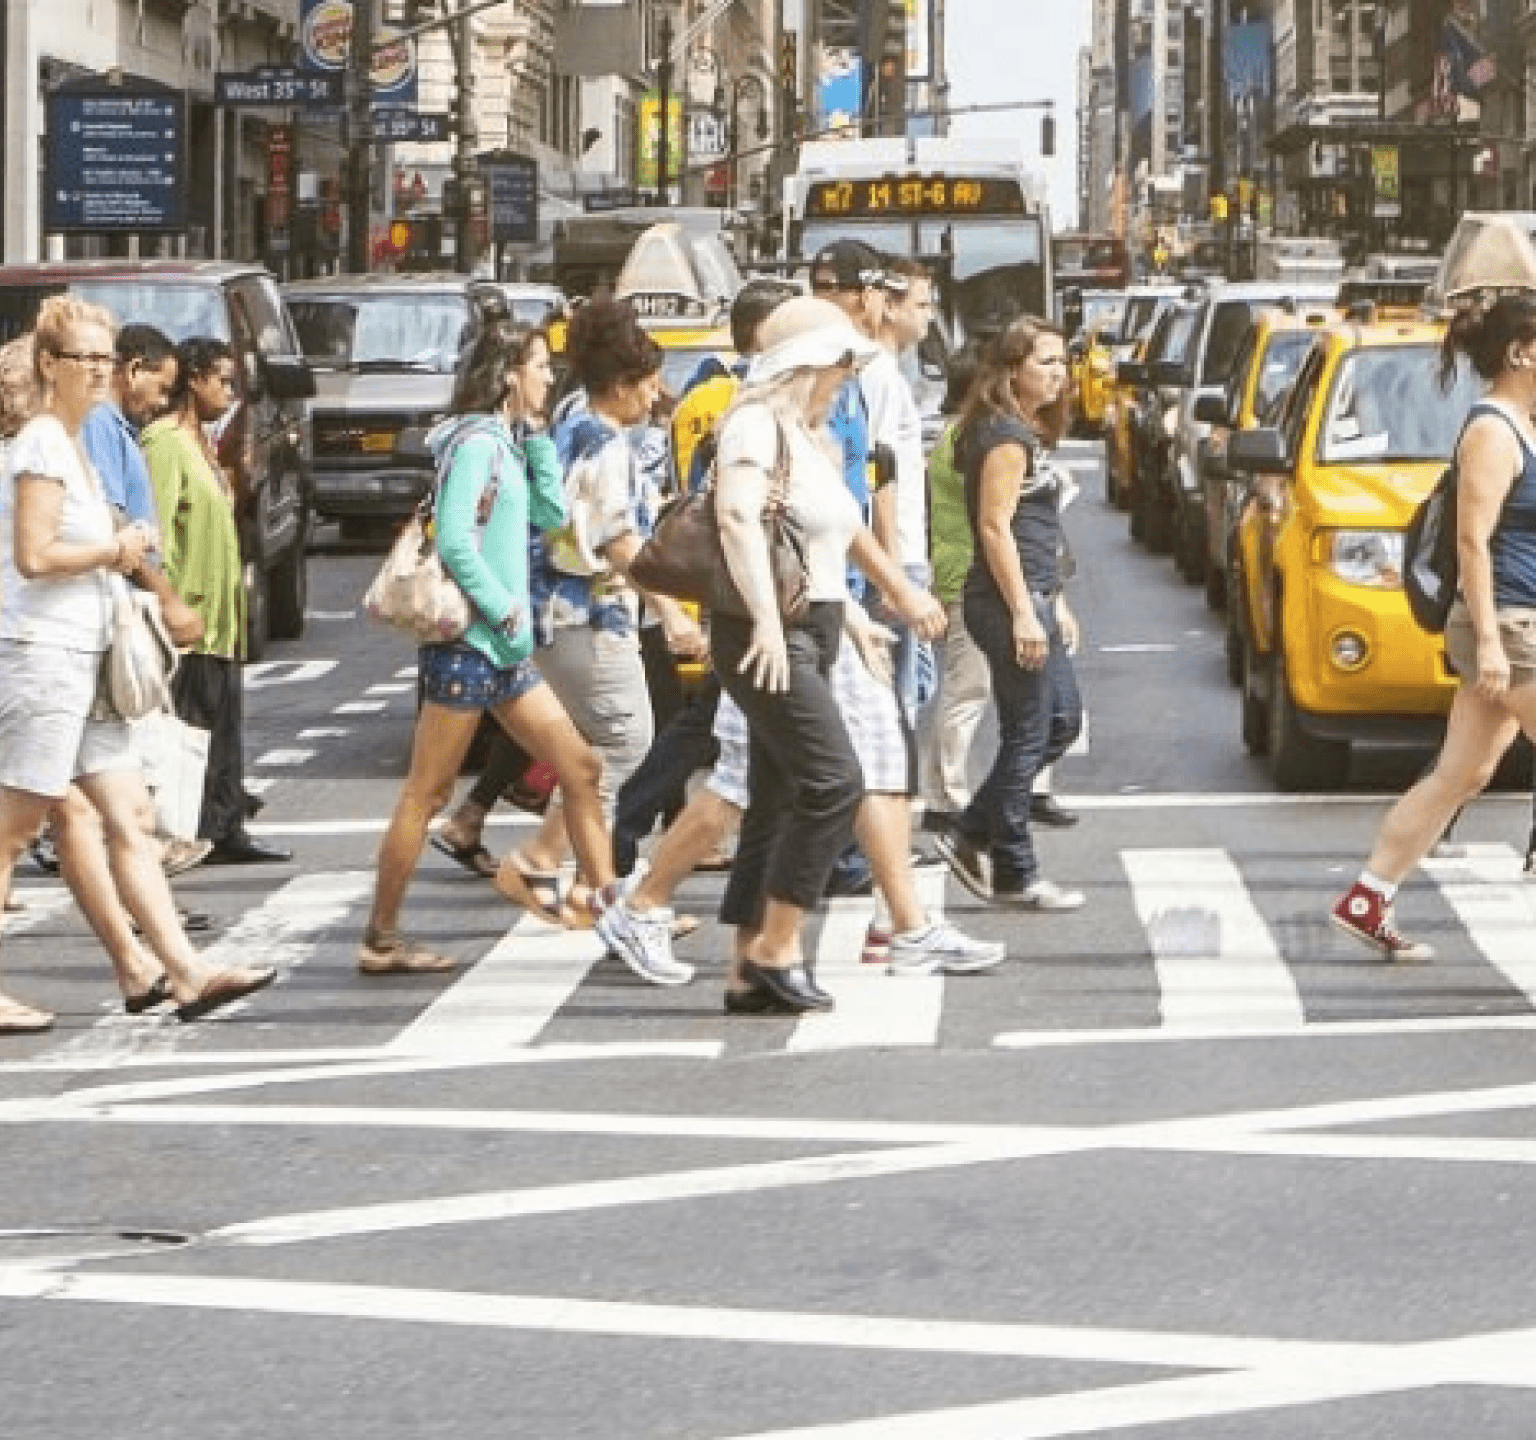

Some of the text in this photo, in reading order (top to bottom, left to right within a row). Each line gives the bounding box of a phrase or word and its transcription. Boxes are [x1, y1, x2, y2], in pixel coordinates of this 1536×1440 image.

[225, 82, 268, 99] West
[309, 81, 329, 99] St
[869, 183, 890, 207] 14
